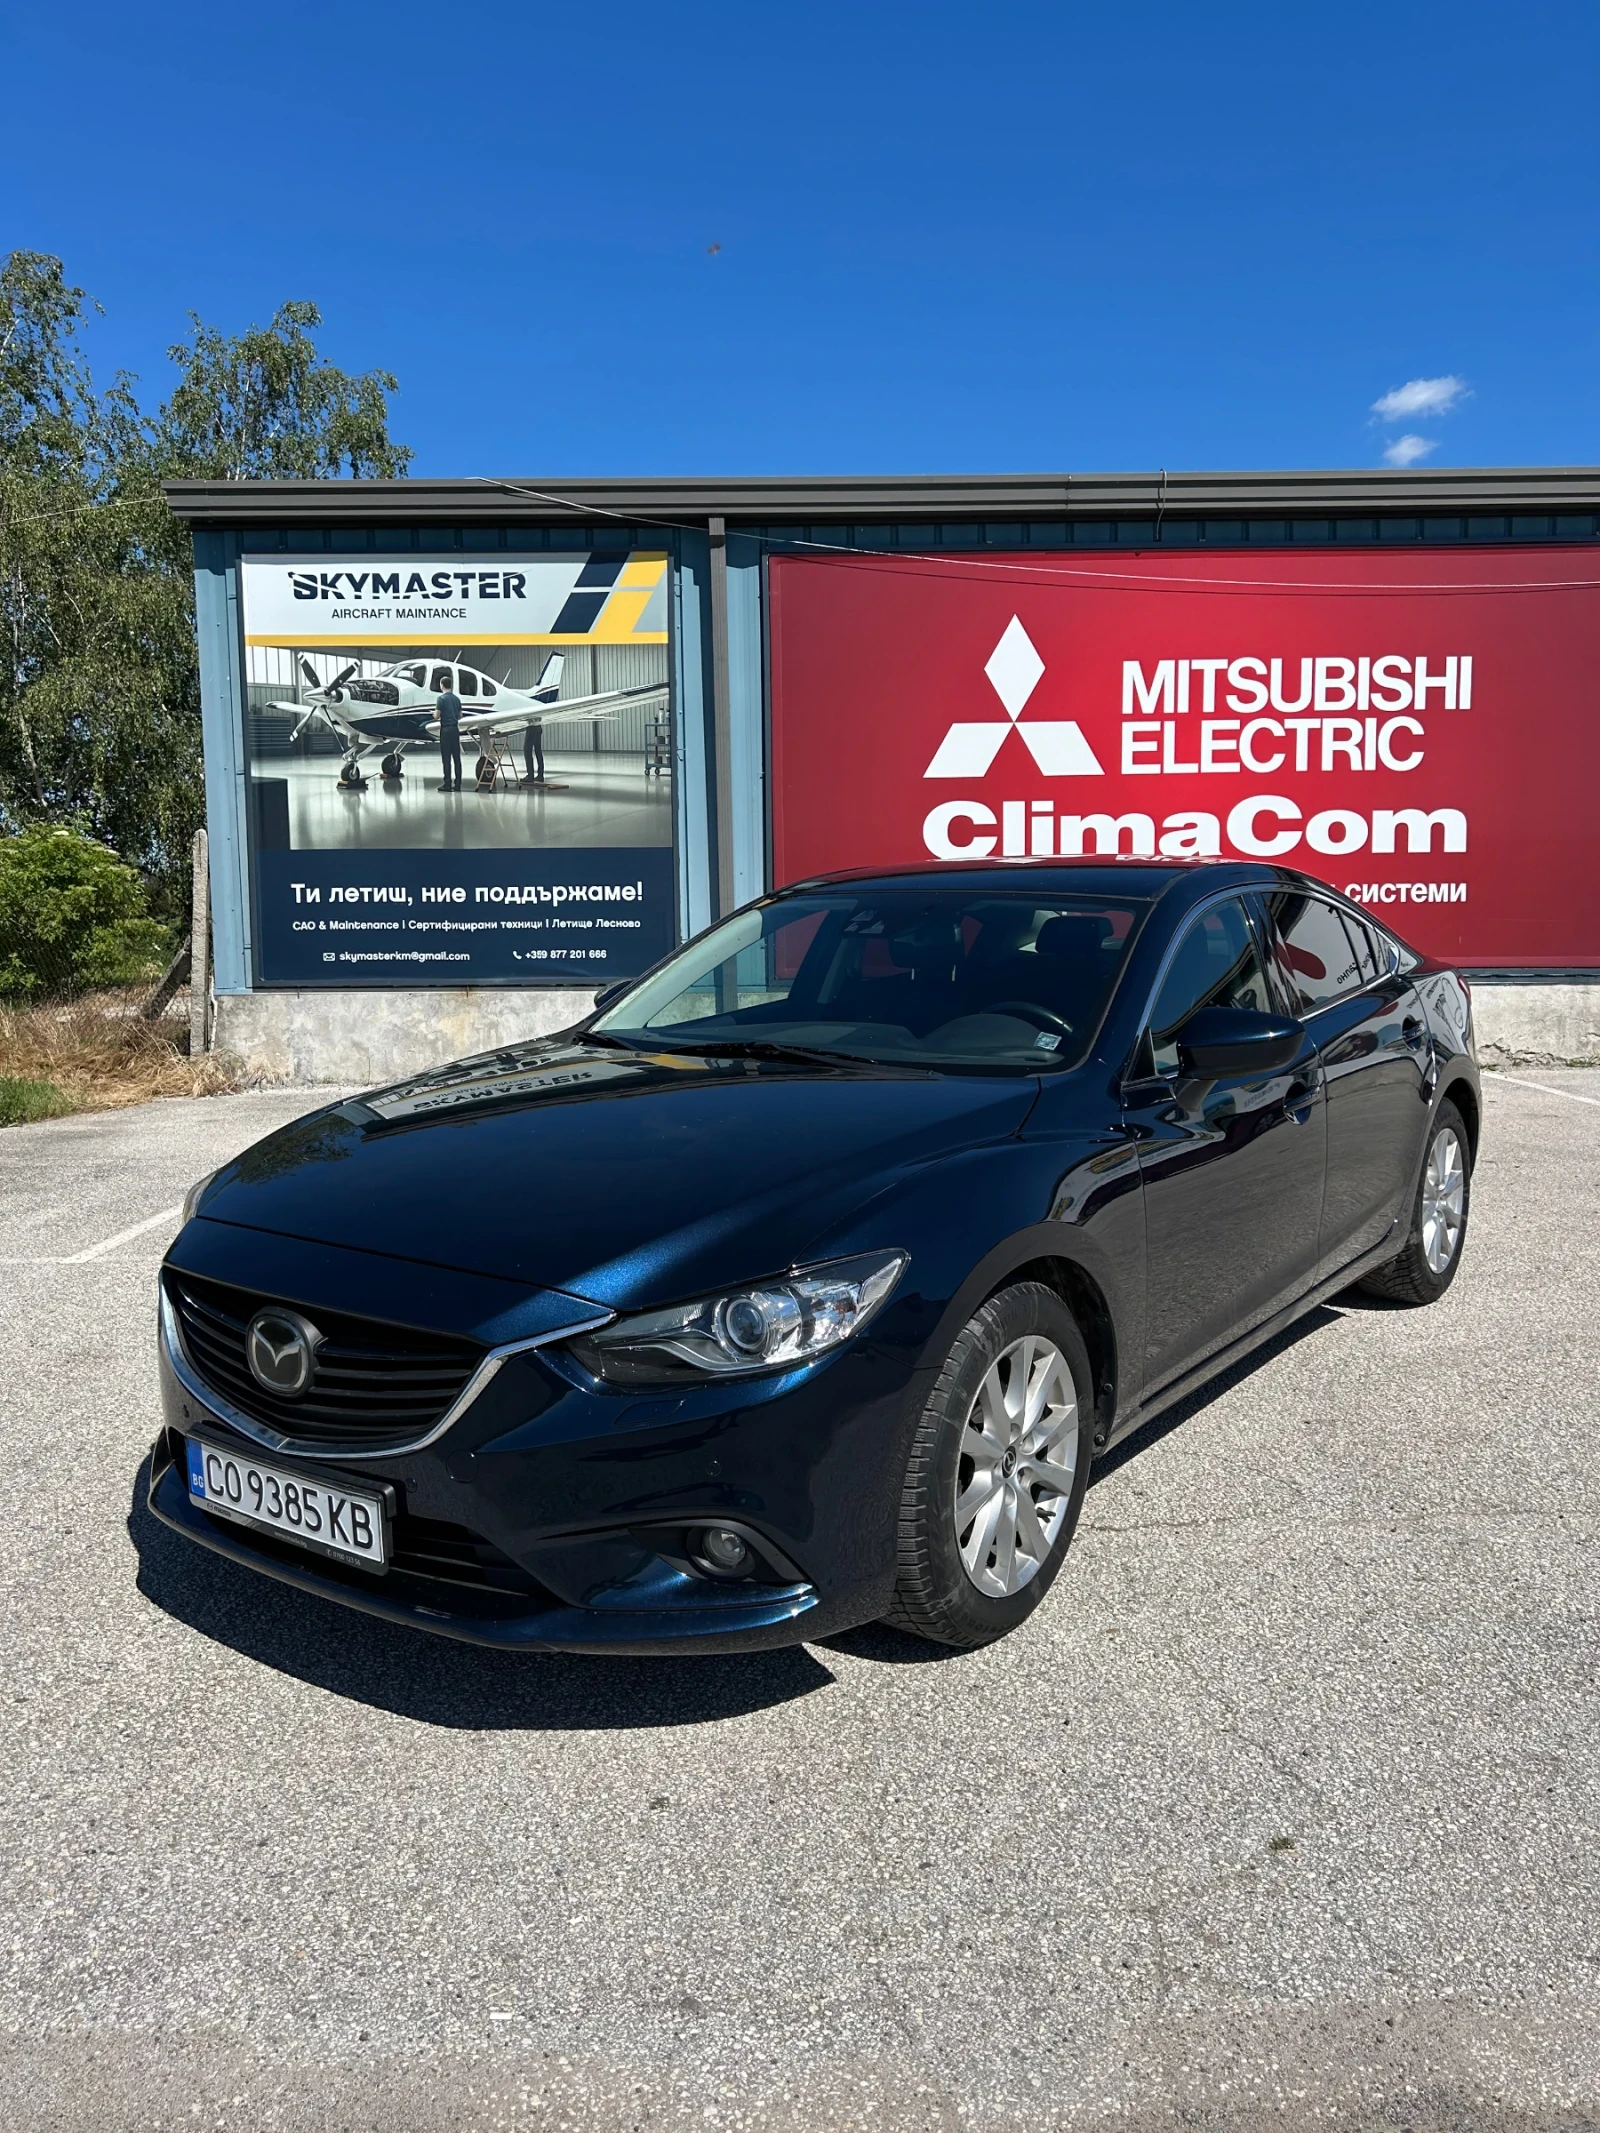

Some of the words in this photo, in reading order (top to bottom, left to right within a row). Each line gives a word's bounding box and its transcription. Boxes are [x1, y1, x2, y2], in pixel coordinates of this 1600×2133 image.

[288, 571, 529, 600] SKYMASTER
[331, 608, 392, 619] AIRCRAFT
[395, 607, 467, 619] MAINTANCE
[1121, 655, 1473, 714] MITSUBISHI
[1121, 715, 1425, 775] ELECTRIC
[922, 795, 1468, 859] ClimaCom
[290, 883, 321, 904] Ти
[421, 886, 467, 903] ние
[475, 881, 644, 907] поддържаме!
[1344, 882, 1468, 904] системи
[318, 921, 327, 930] &
[329, 920, 400, 930] Maintenance
[408, 920, 498, 932] Сертифицирани
[500, 920, 543, 930] техници
[552, 919, 593, 929] Летище
[595, 918, 641, 928] Лесново
[339, 951, 471, 963] skymasterkm@gmail.com
[525, 950, 548, 960] +359
[550, 949, 567, 959] 877
[569, 949, 586, 959] 201
[589, 949, 607, 959] 666
[192, 1472, 204, 1489] BG
[206, 1453, 243, 1503] CO
[247, 1469, 323, 1533] 9385
[327, 1494, 374, 1550] KB
